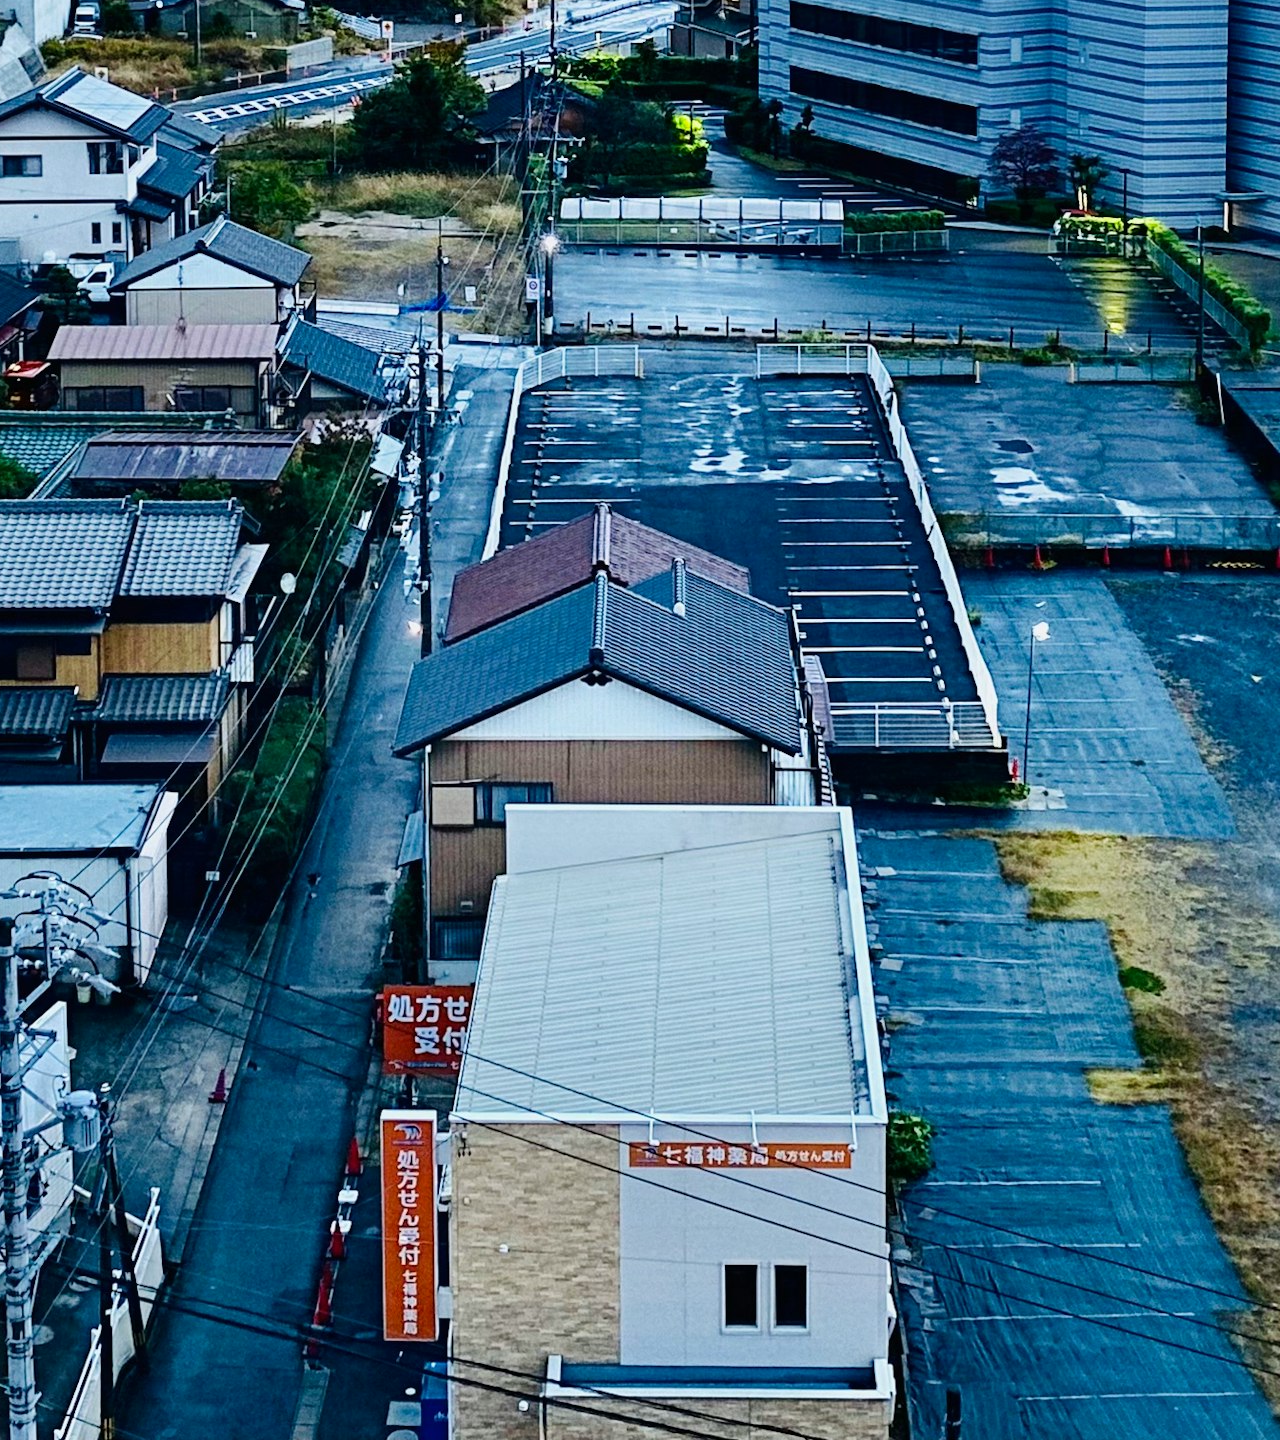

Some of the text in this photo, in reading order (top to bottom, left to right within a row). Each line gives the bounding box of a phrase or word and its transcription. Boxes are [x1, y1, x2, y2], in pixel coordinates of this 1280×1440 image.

[387, 994, 469, 1023] 処方せ
[414, 1026, 467, 1055] 受付
[662, 1146, 845, 1165] 七福神薬局 処方せん受付
[397, 1150, 421, 1266] 処方せん受付
[402, 1269, 419, 1335] 七福神薬局
